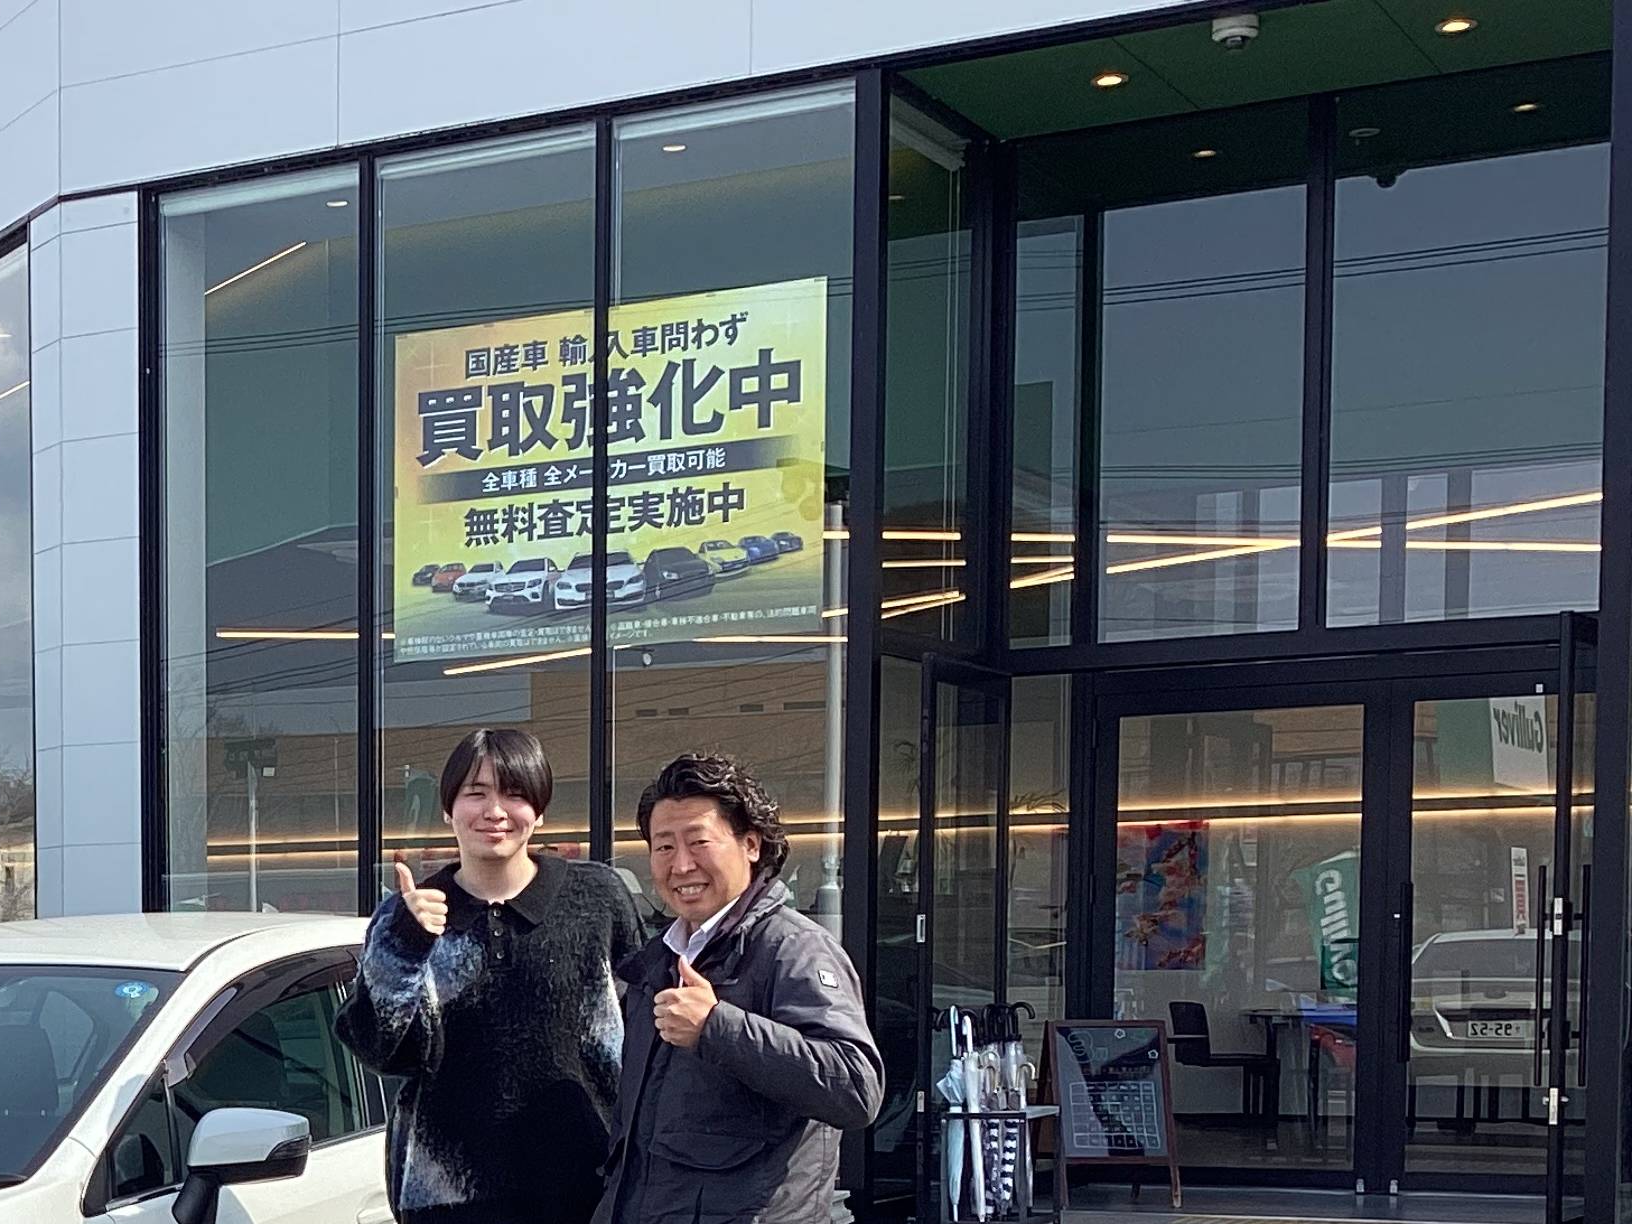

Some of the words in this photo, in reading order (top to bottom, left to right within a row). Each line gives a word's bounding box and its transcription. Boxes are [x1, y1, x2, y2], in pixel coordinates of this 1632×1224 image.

[465, 339, 549, 379] 国産車
[416, 348, 802, 467] 買取強化中
[482, 467, 537, 493] 全車種
[544, 447, 726, 488] 全メーカー買取可能
[464, 481, 746, 548] 無料査定実施中
